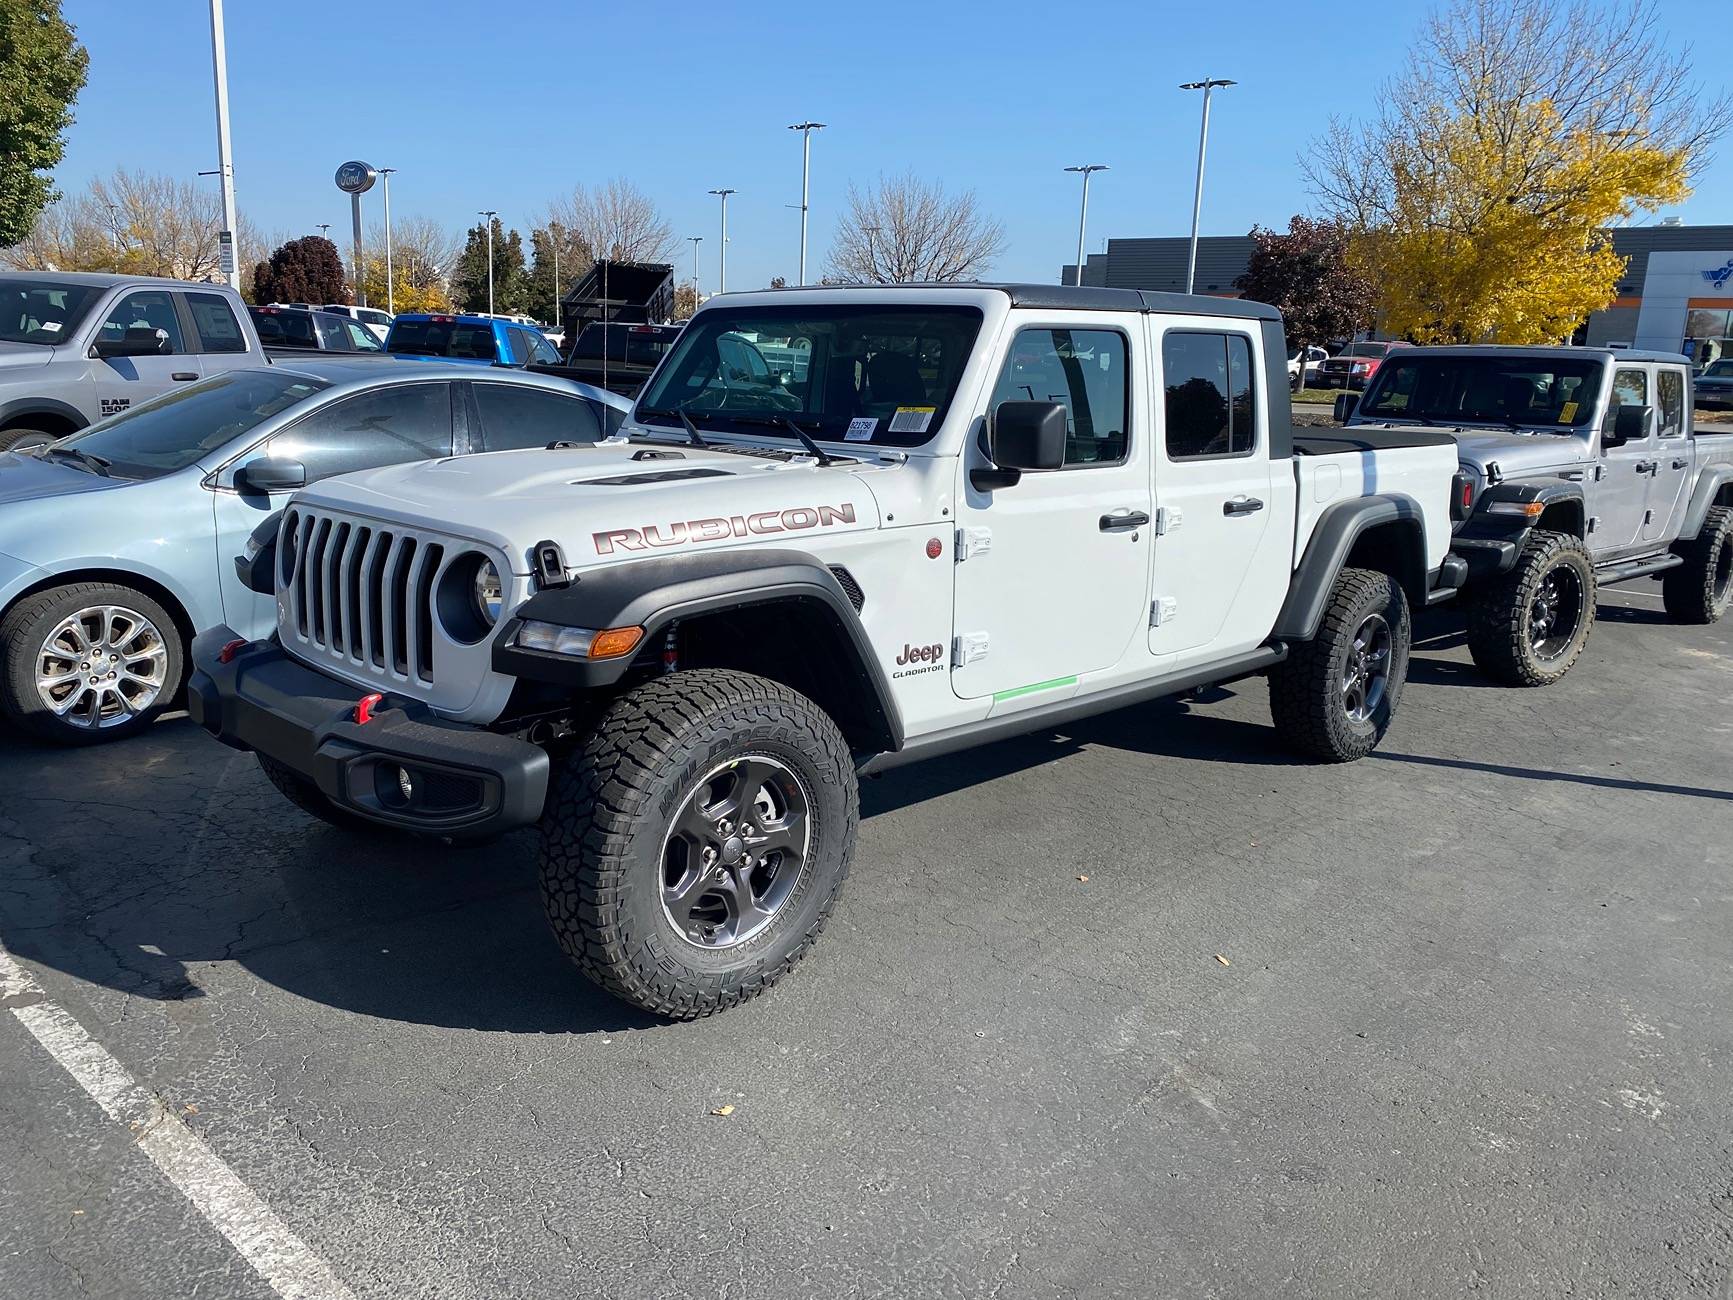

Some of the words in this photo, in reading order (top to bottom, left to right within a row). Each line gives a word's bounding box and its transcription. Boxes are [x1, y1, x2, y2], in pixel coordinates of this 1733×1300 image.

[340, 167, 361, 187] Ford
[591, 503, 857, 555] RUBICON
[896, 643, 944, 666] Jeep
[892, 665, 945, 679] GLADIATOR
